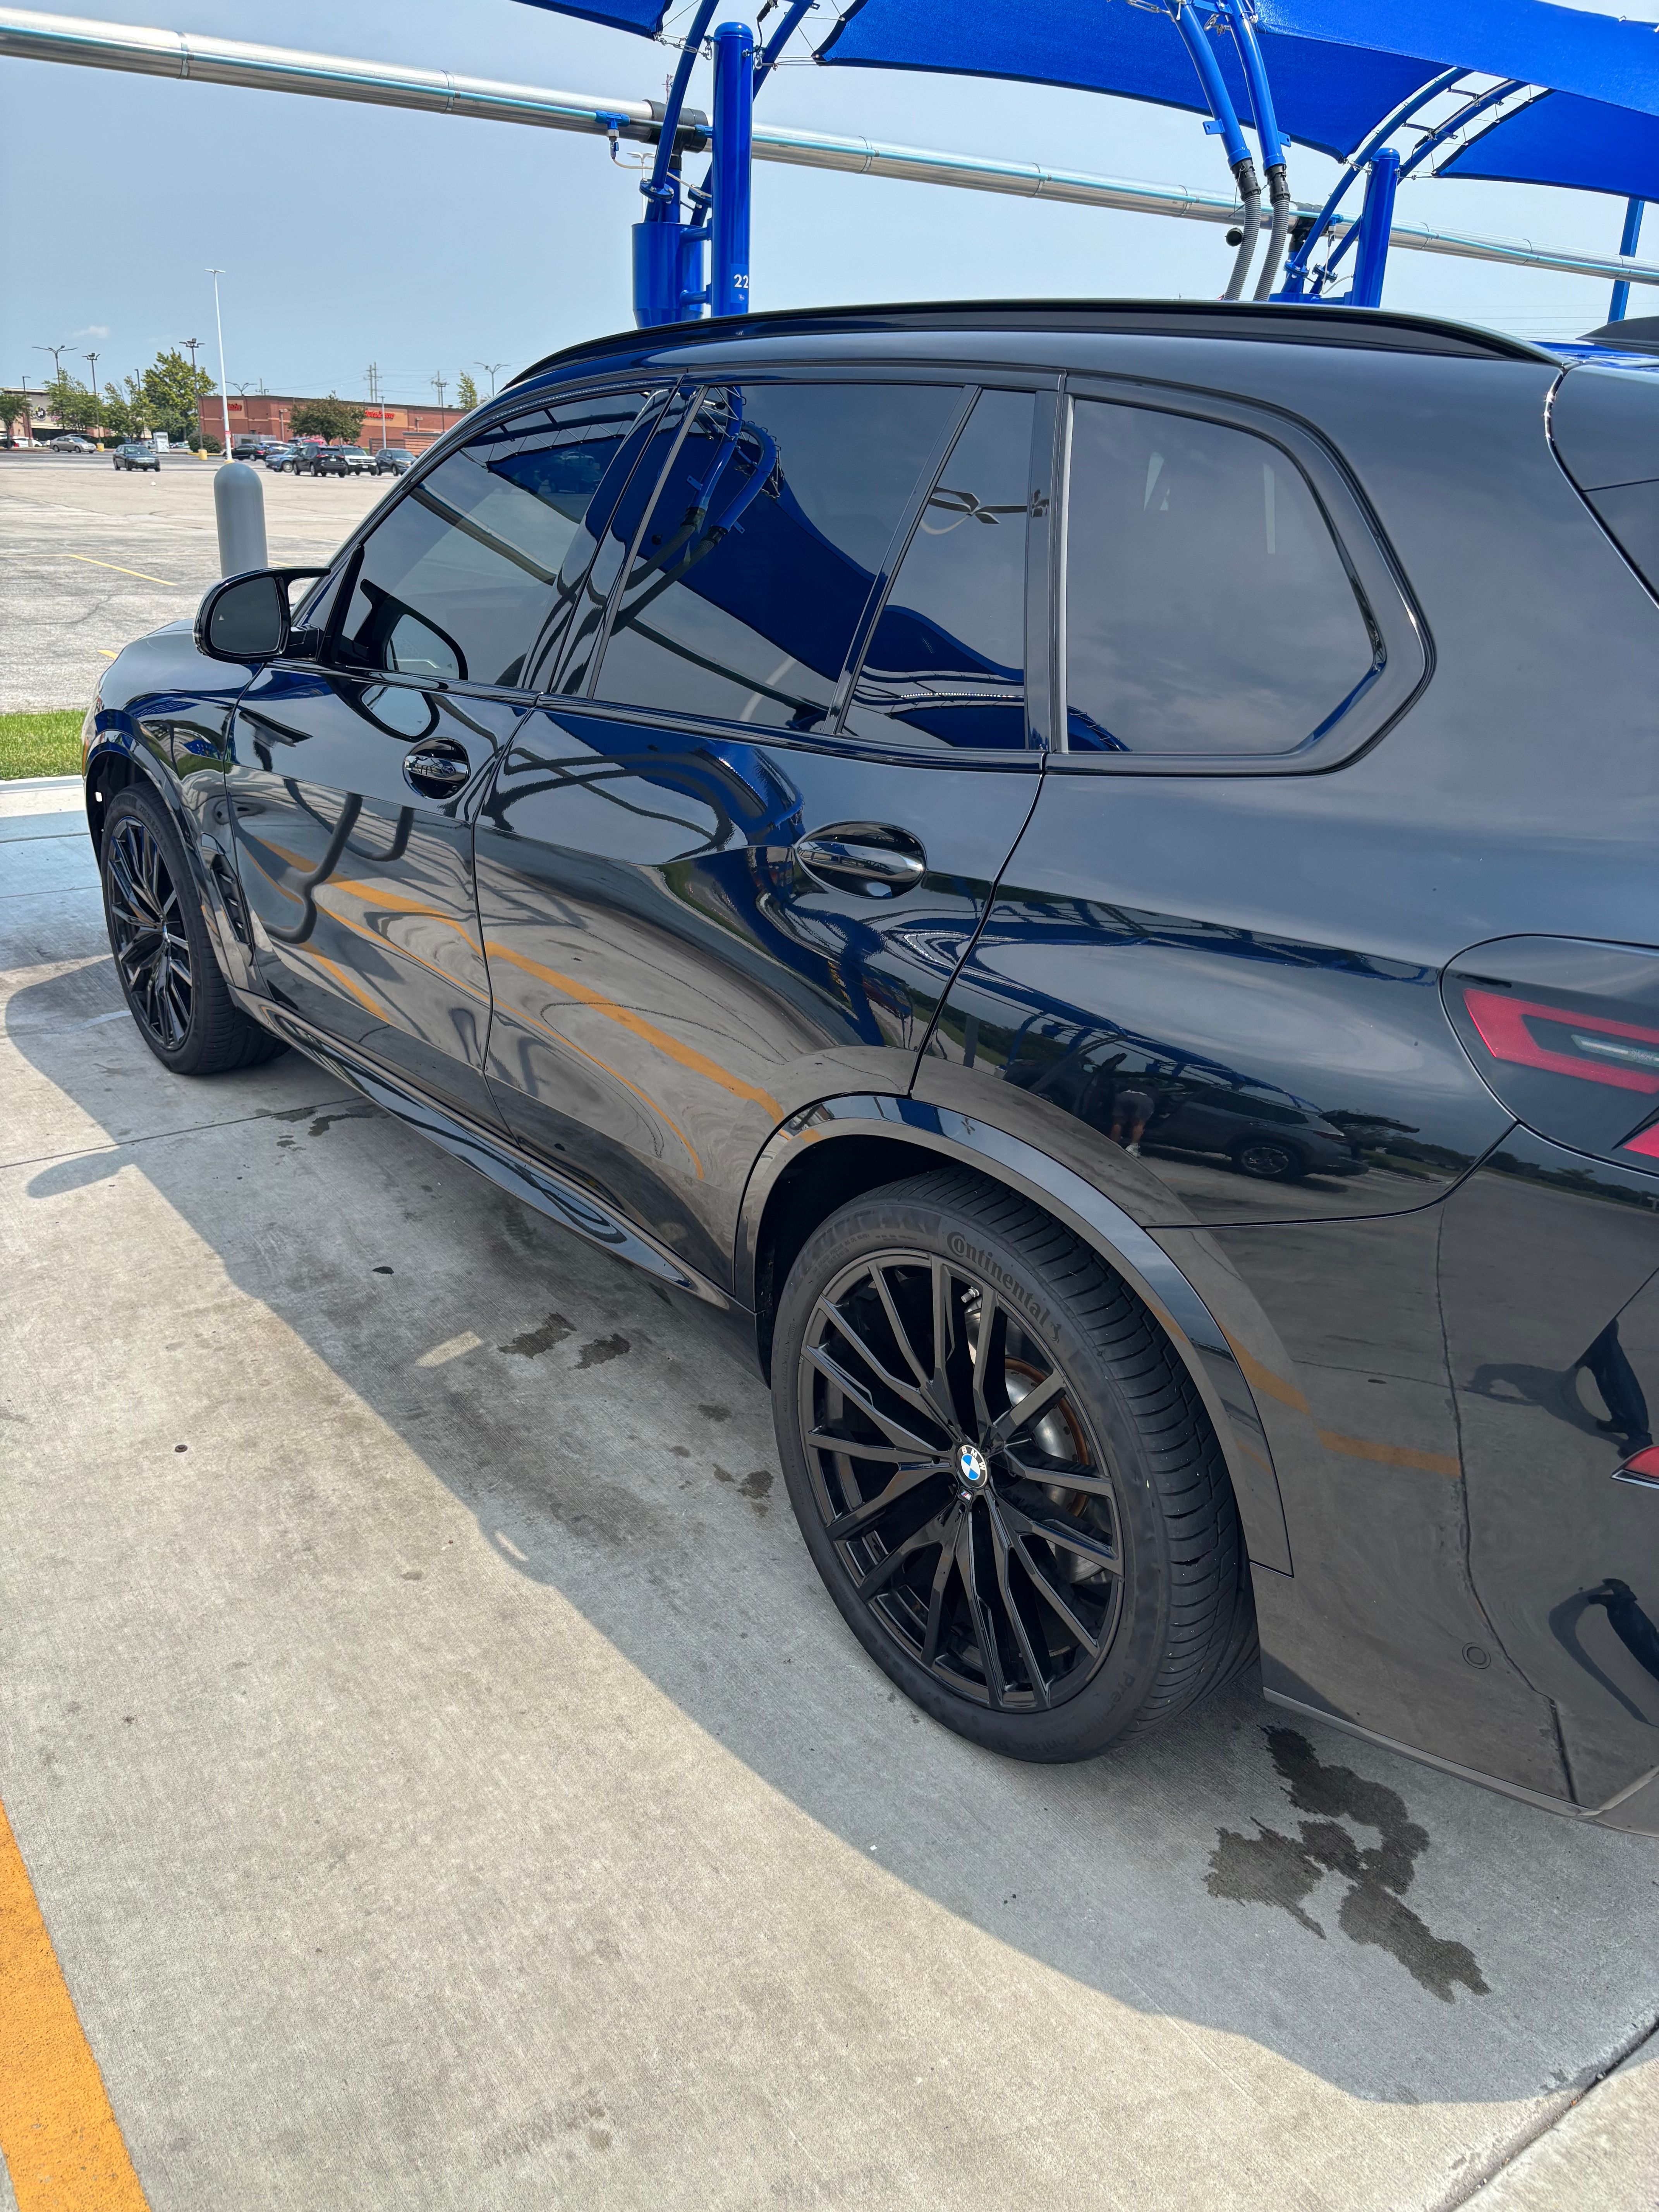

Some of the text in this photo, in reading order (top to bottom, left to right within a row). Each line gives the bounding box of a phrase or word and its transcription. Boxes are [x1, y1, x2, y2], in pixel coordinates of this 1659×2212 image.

[733, 274, 749, 289] 22
[946, 1231, 1051, 1328] Continental
[961, 1446, 986, 1471] BMW
